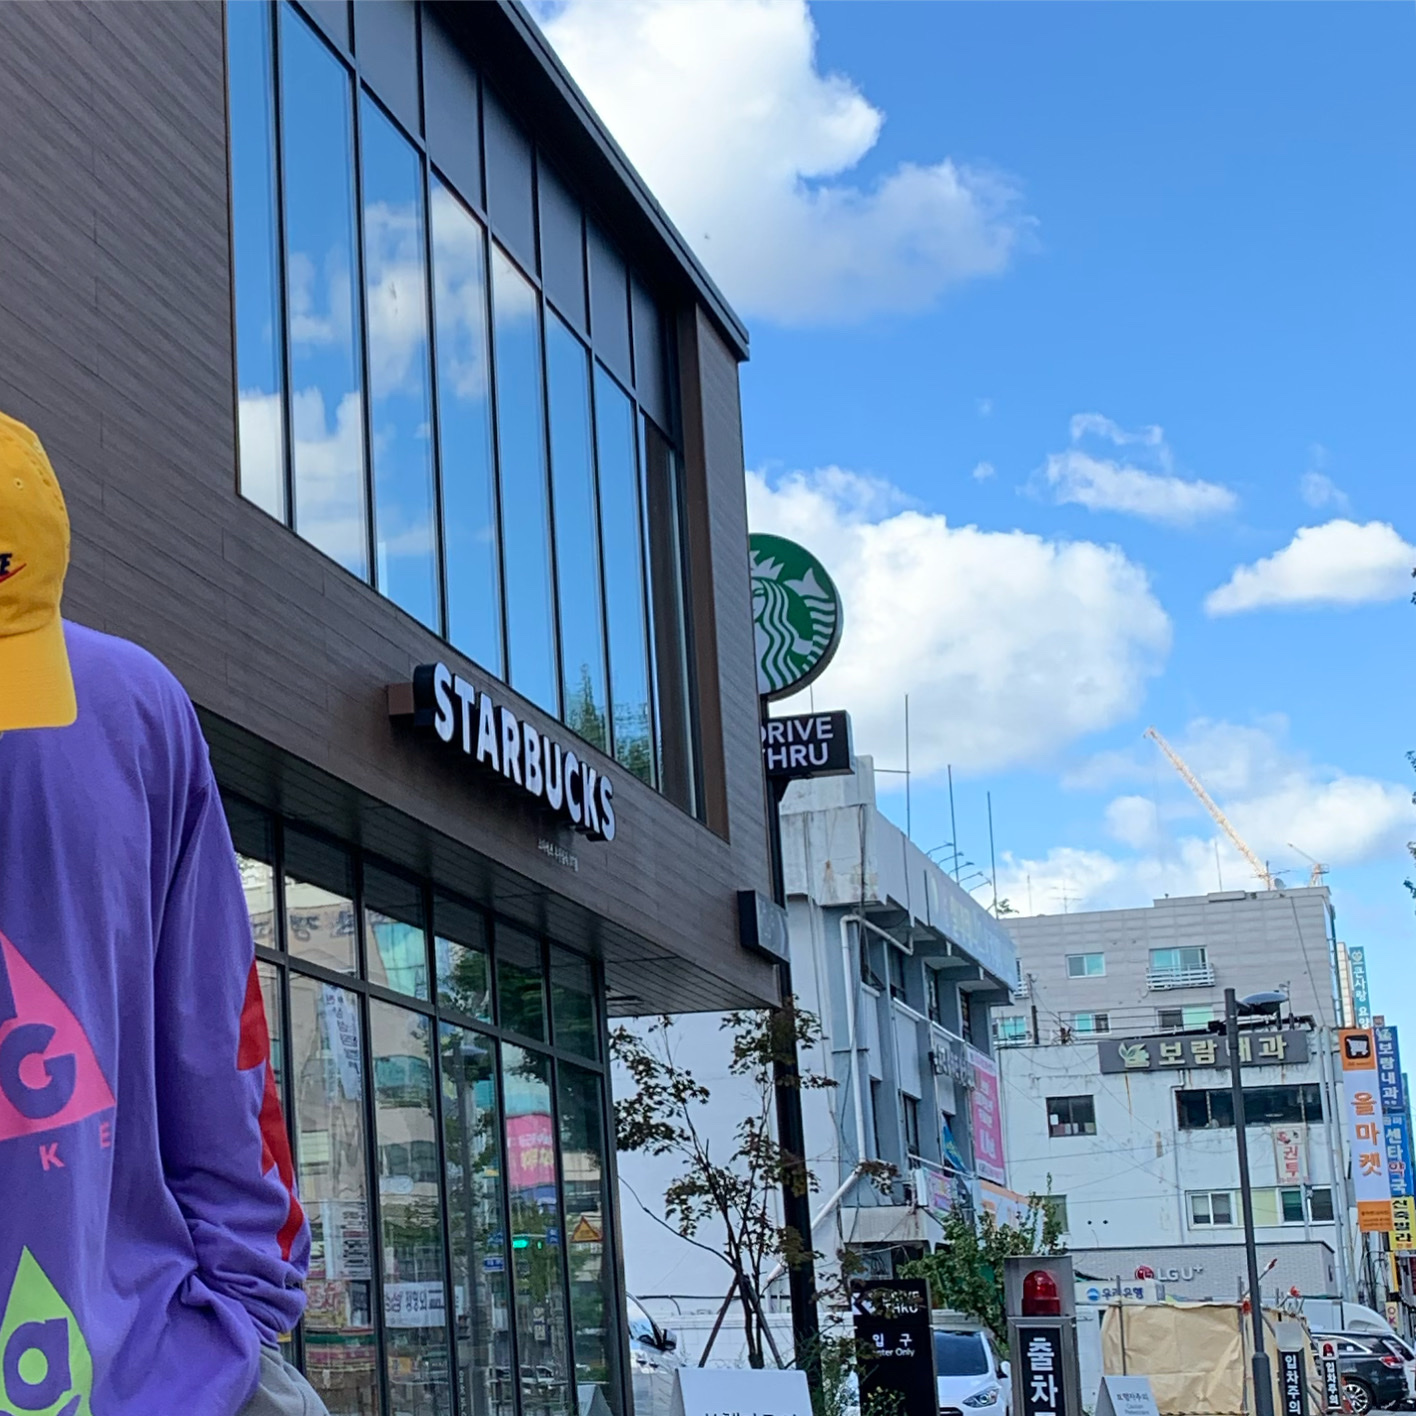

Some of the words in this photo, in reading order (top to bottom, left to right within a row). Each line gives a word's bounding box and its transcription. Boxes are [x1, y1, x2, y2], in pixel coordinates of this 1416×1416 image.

[434, 661, 616, 841] STARBUCKS
[762, 742, 829, 770] HRU
[873, 1348, 893, 1356] nter
[895, 1347, 915, 1357] Only
[1285, 1354, 1301, 1415] 입차주의
